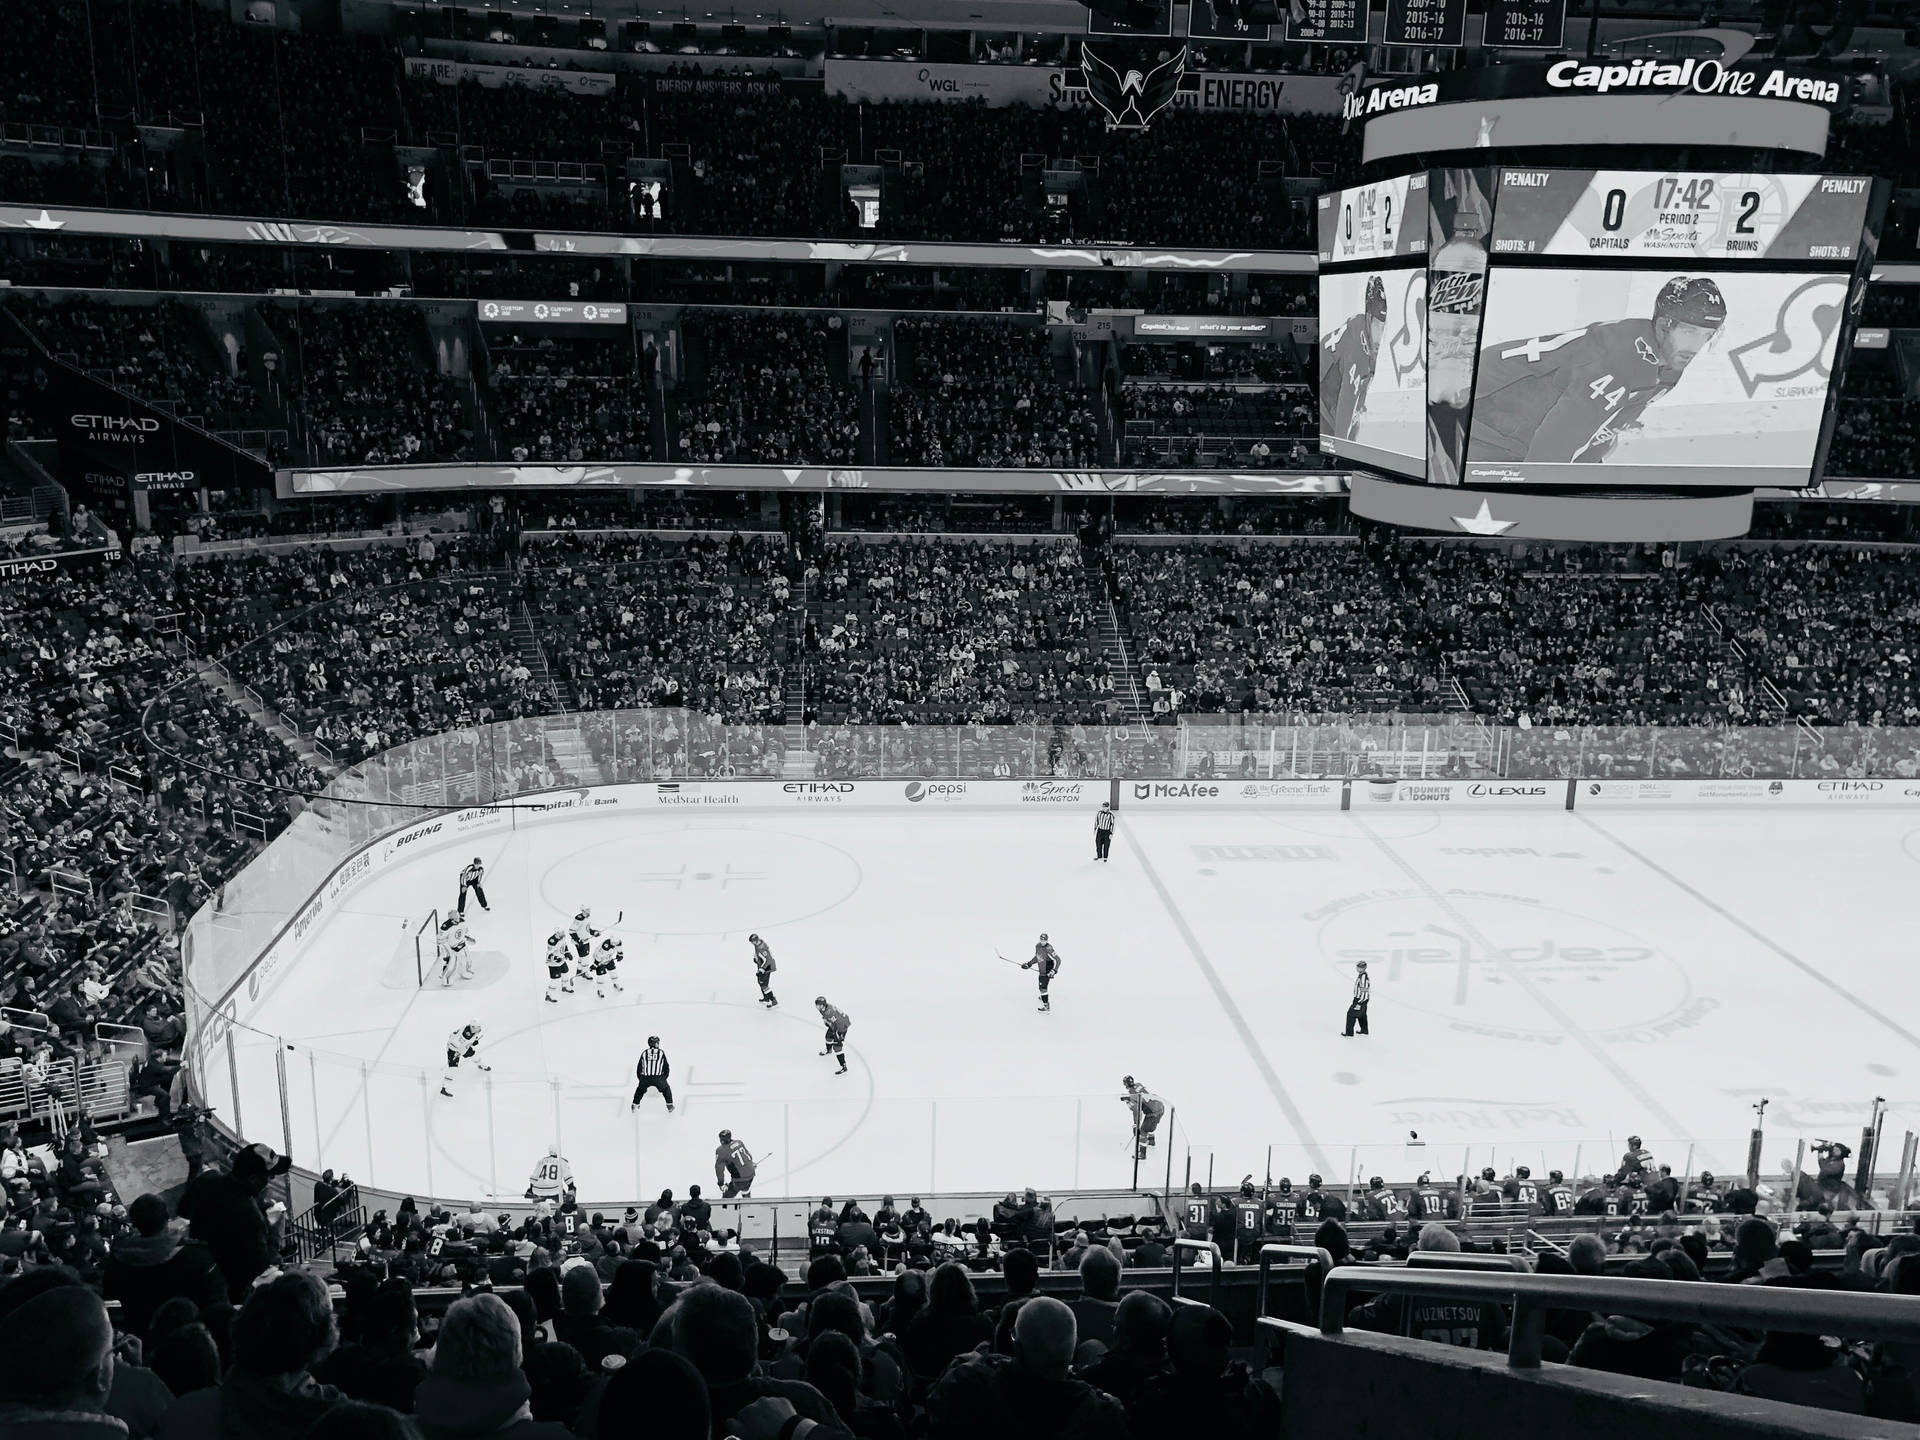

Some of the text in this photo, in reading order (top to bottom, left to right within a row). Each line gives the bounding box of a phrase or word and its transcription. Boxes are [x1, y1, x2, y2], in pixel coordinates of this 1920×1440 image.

[1406, 11, 1445, 24] 2015-16
[1506, 12, 1545, 26] 2015-16
[1404, 26, 1444, 40] 2016-17
[1504, 27, 1544, 41] 2016-17
[410, 63, 427, 77] WE
[656, 80, 692, 94] ENERGY
[929, 79, 961, 92] WGL
[1758, 70, 1840, 104] Arena
[1203, 79, 1285, 111] ENERGY
[1366, 83, 1440, 113] Arena
[1503, 172, 1549, 188] PENALTY
[1820, 179, 1866, 194] PENALTY
[1651, 177, 1714, 212] 17:42
[1385, 196, 1392, 235] 2
[1602, 188, 1627, 231] 0
[1735, 191, 1760, 234] 2
[1345, 204, 1352, 240] 0
[1658, 213, 1700, 225] PERIOD 2
[1495, 239, 1528, 252] SHOTS:
[1589, 238, 1629, 250] CAPITALS
[1643, 241, 1697, 250] WASHINGTON
[1725, 240, 1759, 252] BRUINS
[1839, 247, 1850, 258] 16
[851, 318, 866, 327] 217
[1097, 321, 1111, 330] 215
[1293, 324, 1308, 333] 215
[1073, 331, 1087, 340] 216
[1588, 374, 1627, 412] 44
[70, 413, 161, 433] ETIHAD
[88, 432, 146, 446] AIRWAYS
[84, 472, 126, 488] ETIHAD
[134, 471, 195, 483] ETIHAD
[146, 482, 187, 490] AIRWAYS
[103, 550, 122, 561] 115
[783, 783, 855, 794] ETIHAD
[928, 782, 968, 797] pepsi
[1039, 781, 1080, 796] Sports
[1154, 783, 1220, 798] McAfee
[1305, 784, 1331, 793] Turtle
[1489, 787, 1547, 796] LEXUS
[1817, 782, 1885, 792] ETIHAD
[595, 798, 619, 806] Bank
[658, 795, 739, 805] MedStar Health
[796, 795, 843, 803] AIRWAYS
[1412, 793, 1451, 801] DONUTS
[396, 823, 443, 848] BOEING
[1390, 1108, 1587, 1132] Red River
[731, 1145, 753, 1167] 77
[538, 1164, 558, 1180] 48
[1518, 1187, 1538, 1203] 43
[1423, 1195, 1440, 1214] 10
[1189, 1204, 1206, 1224] 31
[1244, 1210, 1255, 1230] 8
[564, 1215, 575, 1235] 8
[430, 1237, 444, 1256] 8
